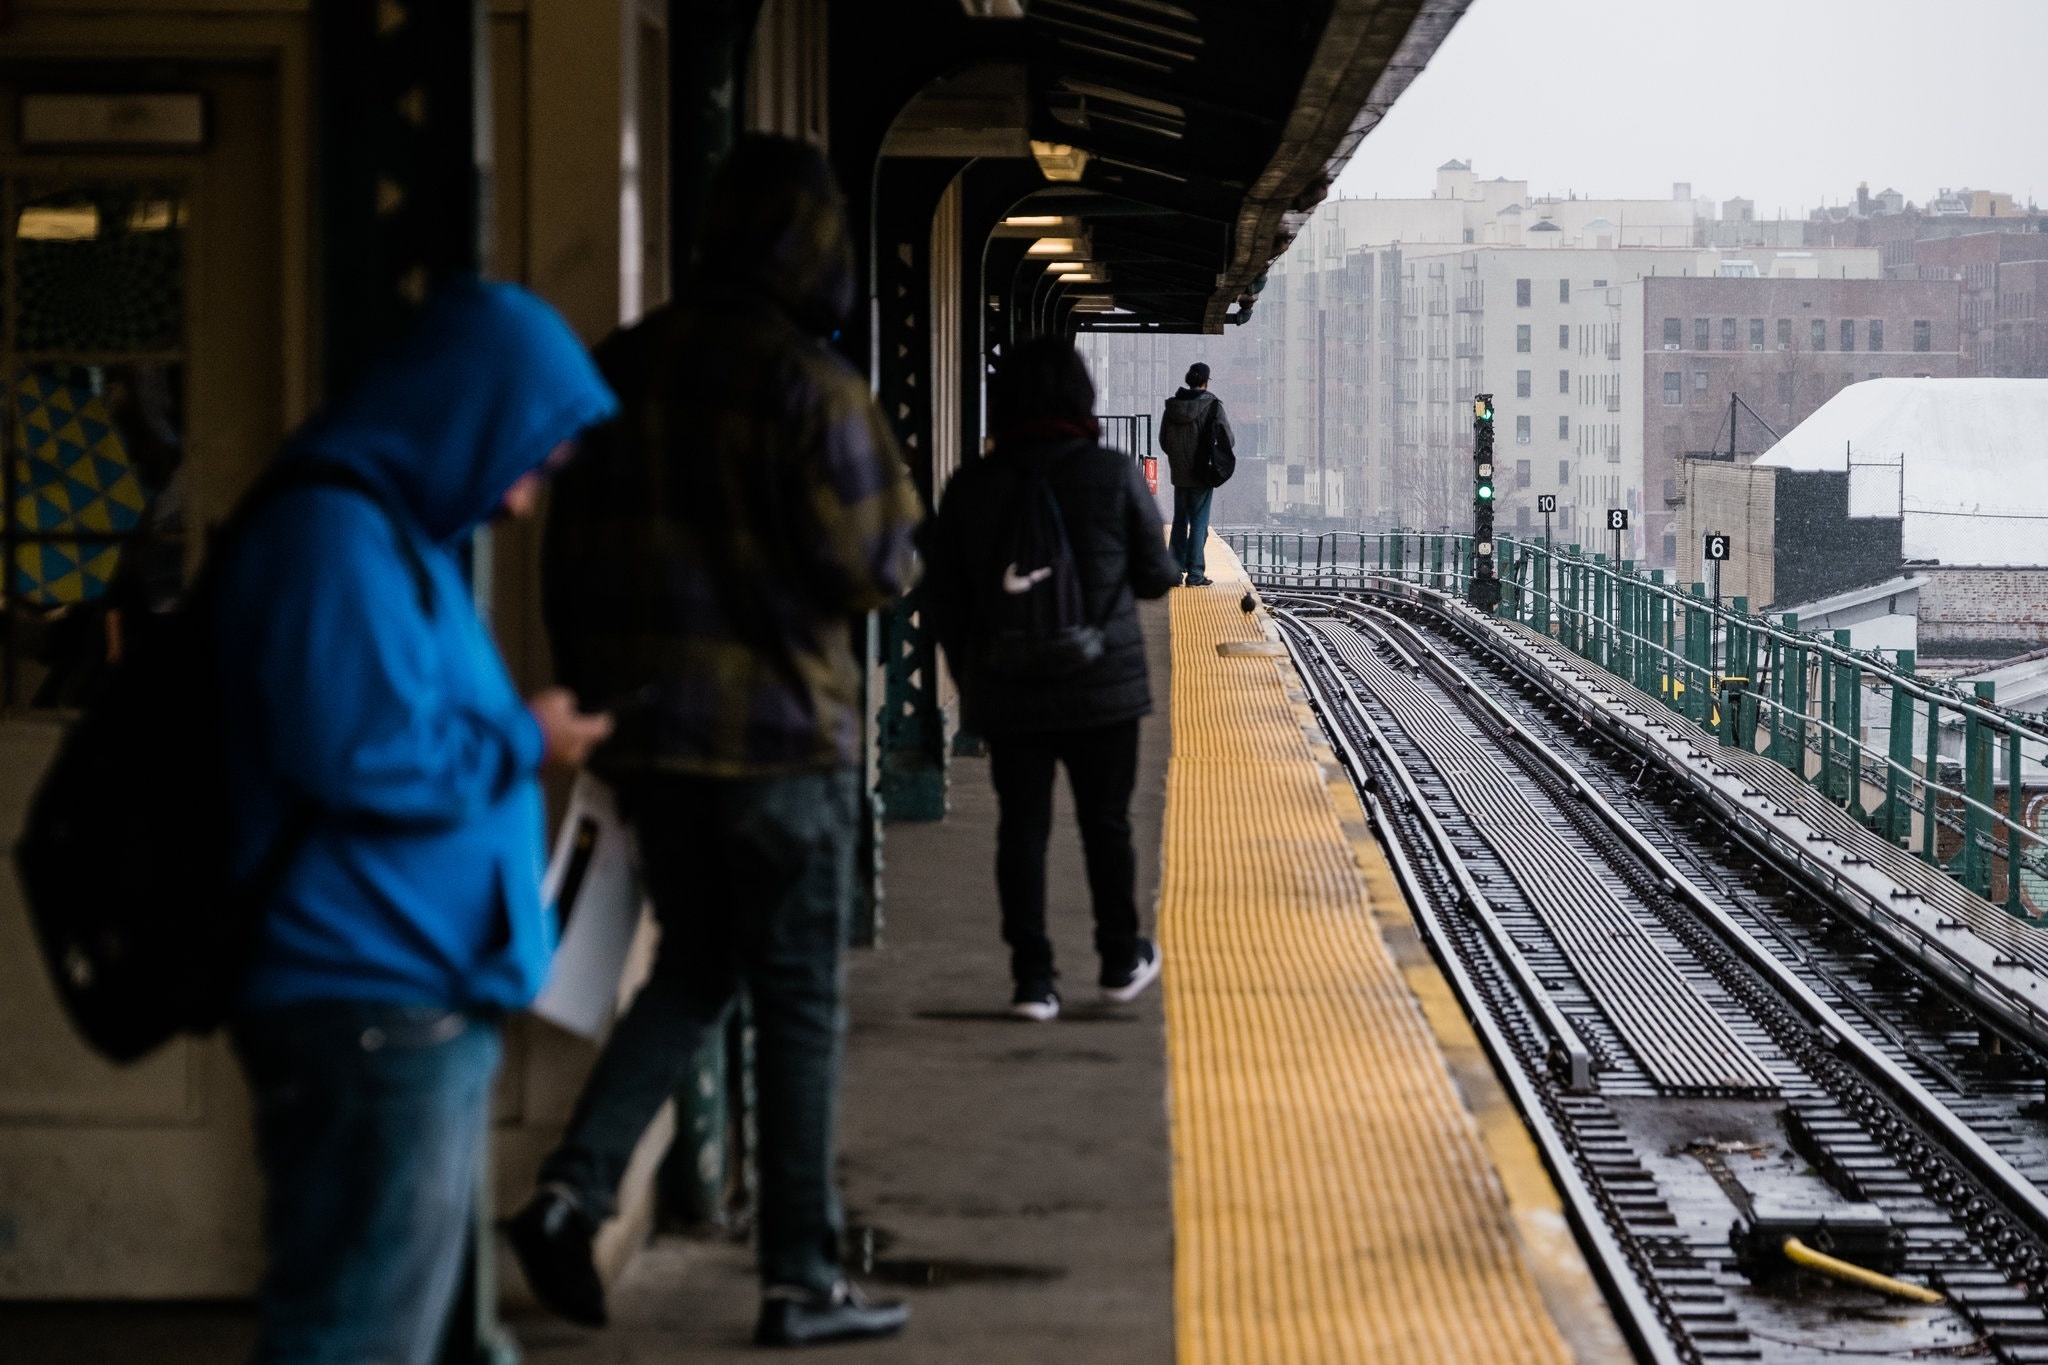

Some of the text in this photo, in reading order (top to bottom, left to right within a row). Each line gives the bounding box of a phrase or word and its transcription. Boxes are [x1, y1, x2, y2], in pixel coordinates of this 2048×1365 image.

[1540, 497, 1554, 511] 10
[1612, 511, 1623, 528] 8
[1711, 537, 1724, 558] 6
